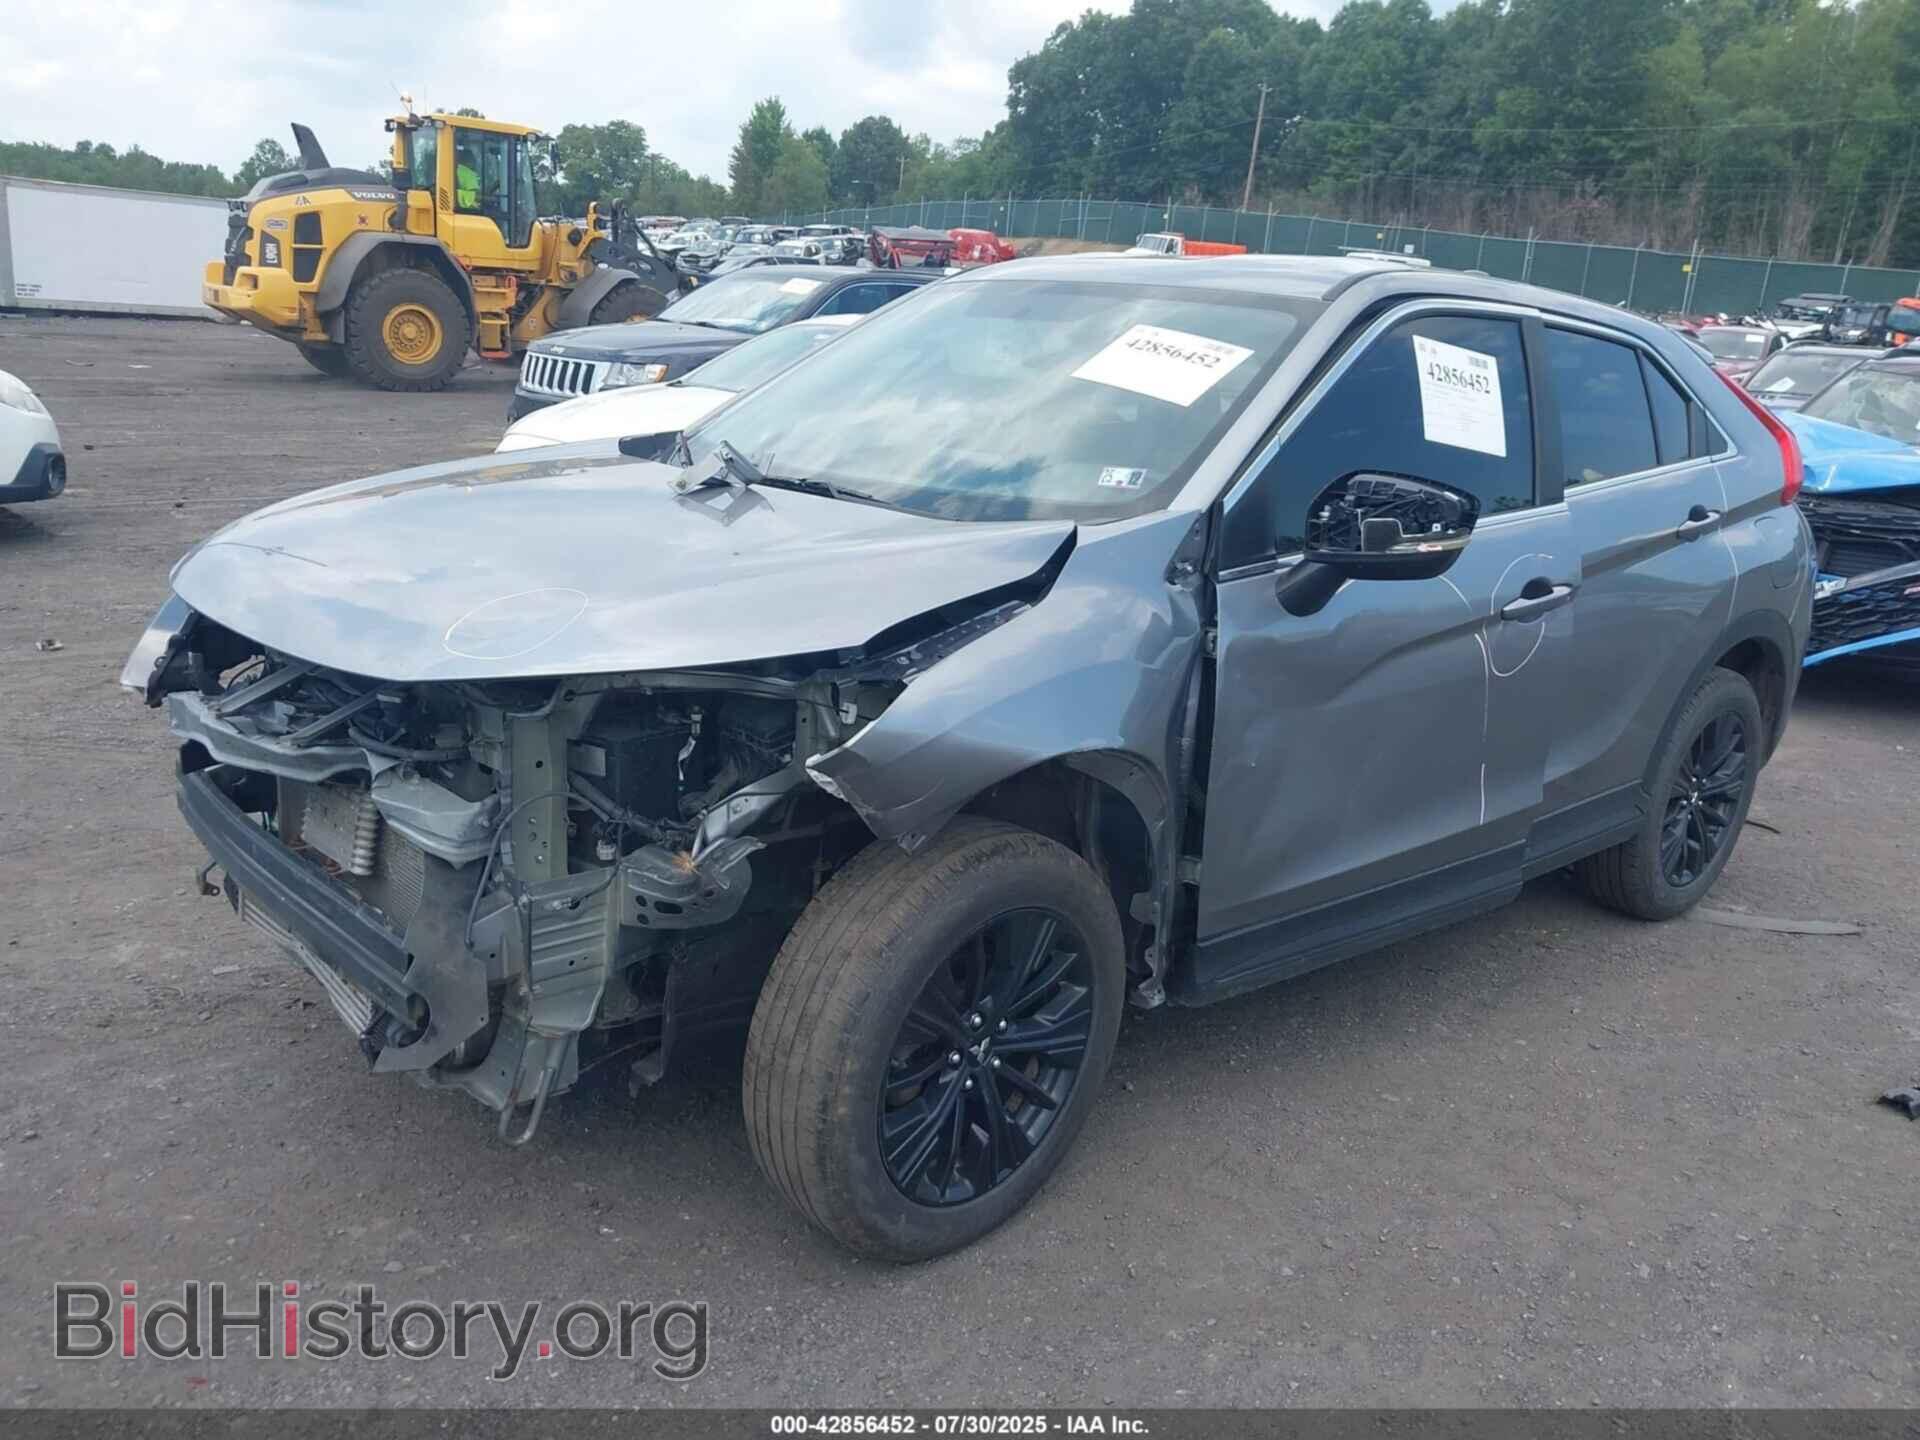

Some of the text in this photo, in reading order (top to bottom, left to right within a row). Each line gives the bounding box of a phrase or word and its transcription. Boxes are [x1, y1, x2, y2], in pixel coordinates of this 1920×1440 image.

[353, 191, 395, 200] VOLVO
[1127, 338, 1221, 368] 42856452
[1427, 362, 1490, 394] 42856452
